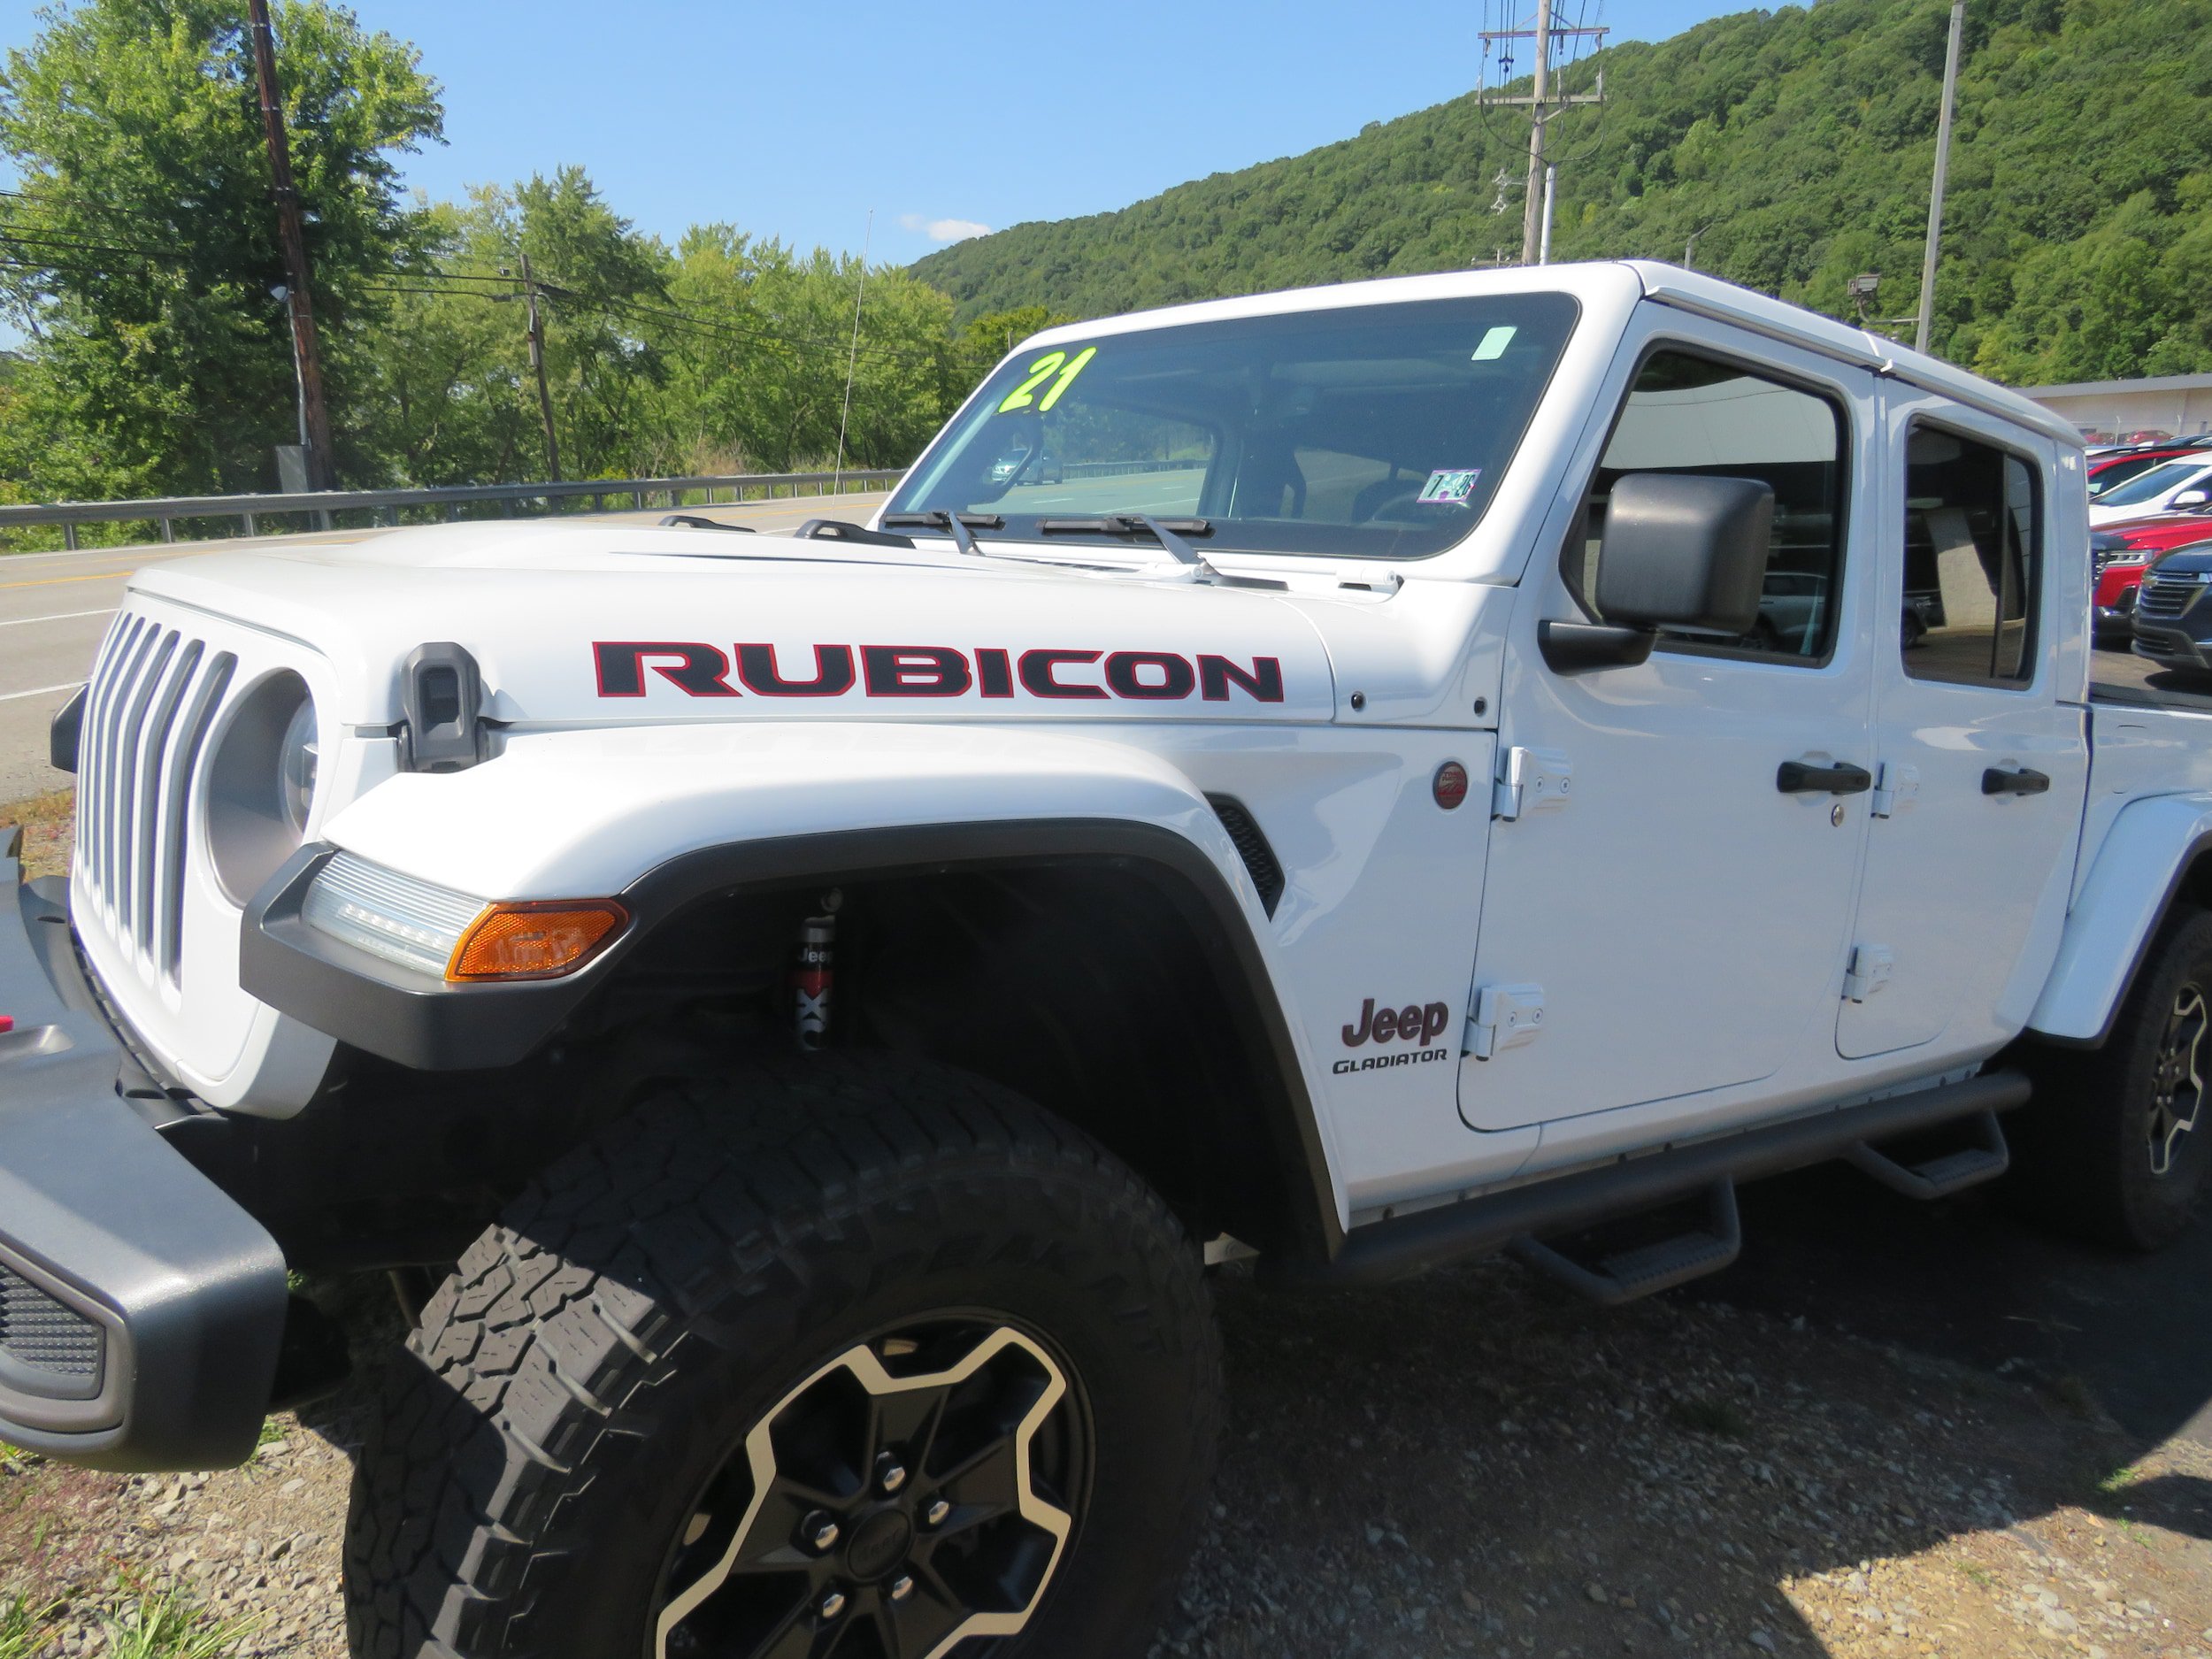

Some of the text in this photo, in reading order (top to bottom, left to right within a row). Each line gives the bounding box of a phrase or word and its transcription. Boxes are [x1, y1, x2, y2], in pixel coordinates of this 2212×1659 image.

[998, 346, 1097, 414] 21
[590, 641, 1285, 703] RUBICON
[1341, 998, 1449, 1048] Jeep
[1333, 1048, 1448, 1075] GLADIATOR
